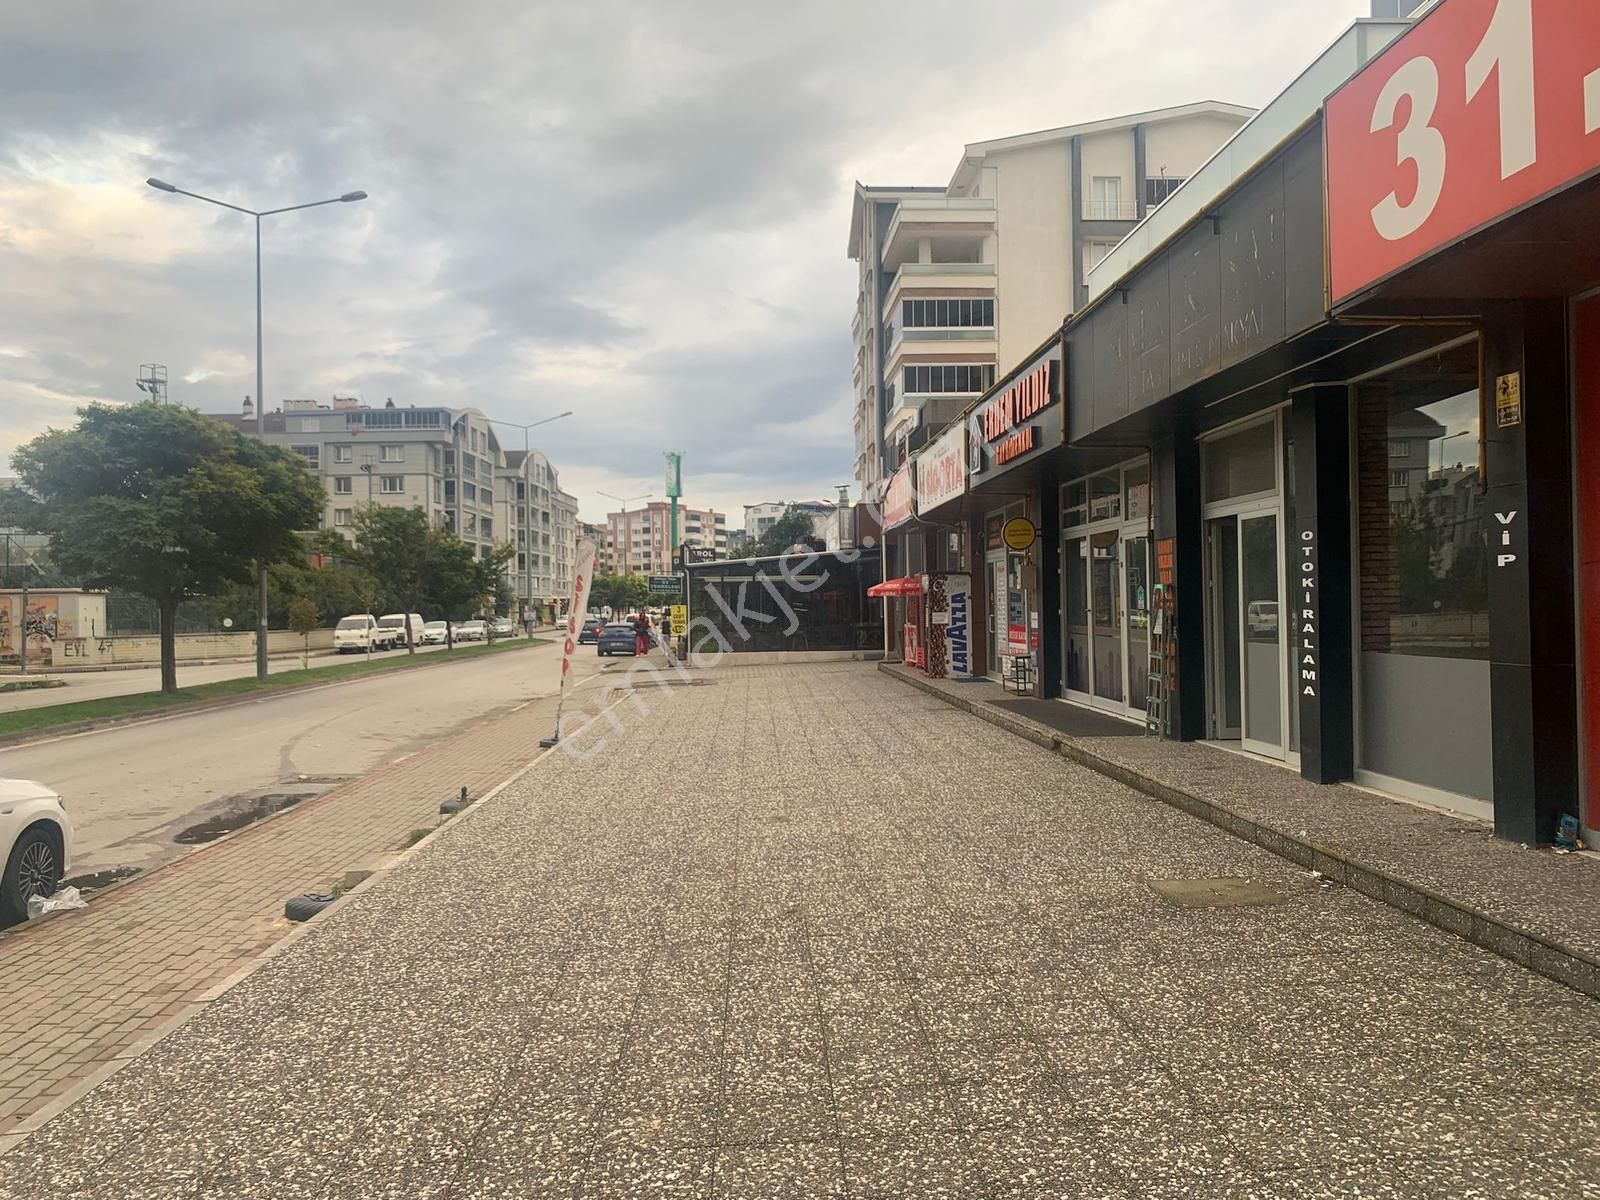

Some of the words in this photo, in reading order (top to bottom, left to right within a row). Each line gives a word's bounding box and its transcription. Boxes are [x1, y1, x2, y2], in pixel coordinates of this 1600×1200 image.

[984, 389, 1013, 443] ERDEM
[1015, 360, 1050, 423] YILDIZ
[1494, 511, 1517, 567] VİP
[945, 592, 968, 673] LAVAZZA
